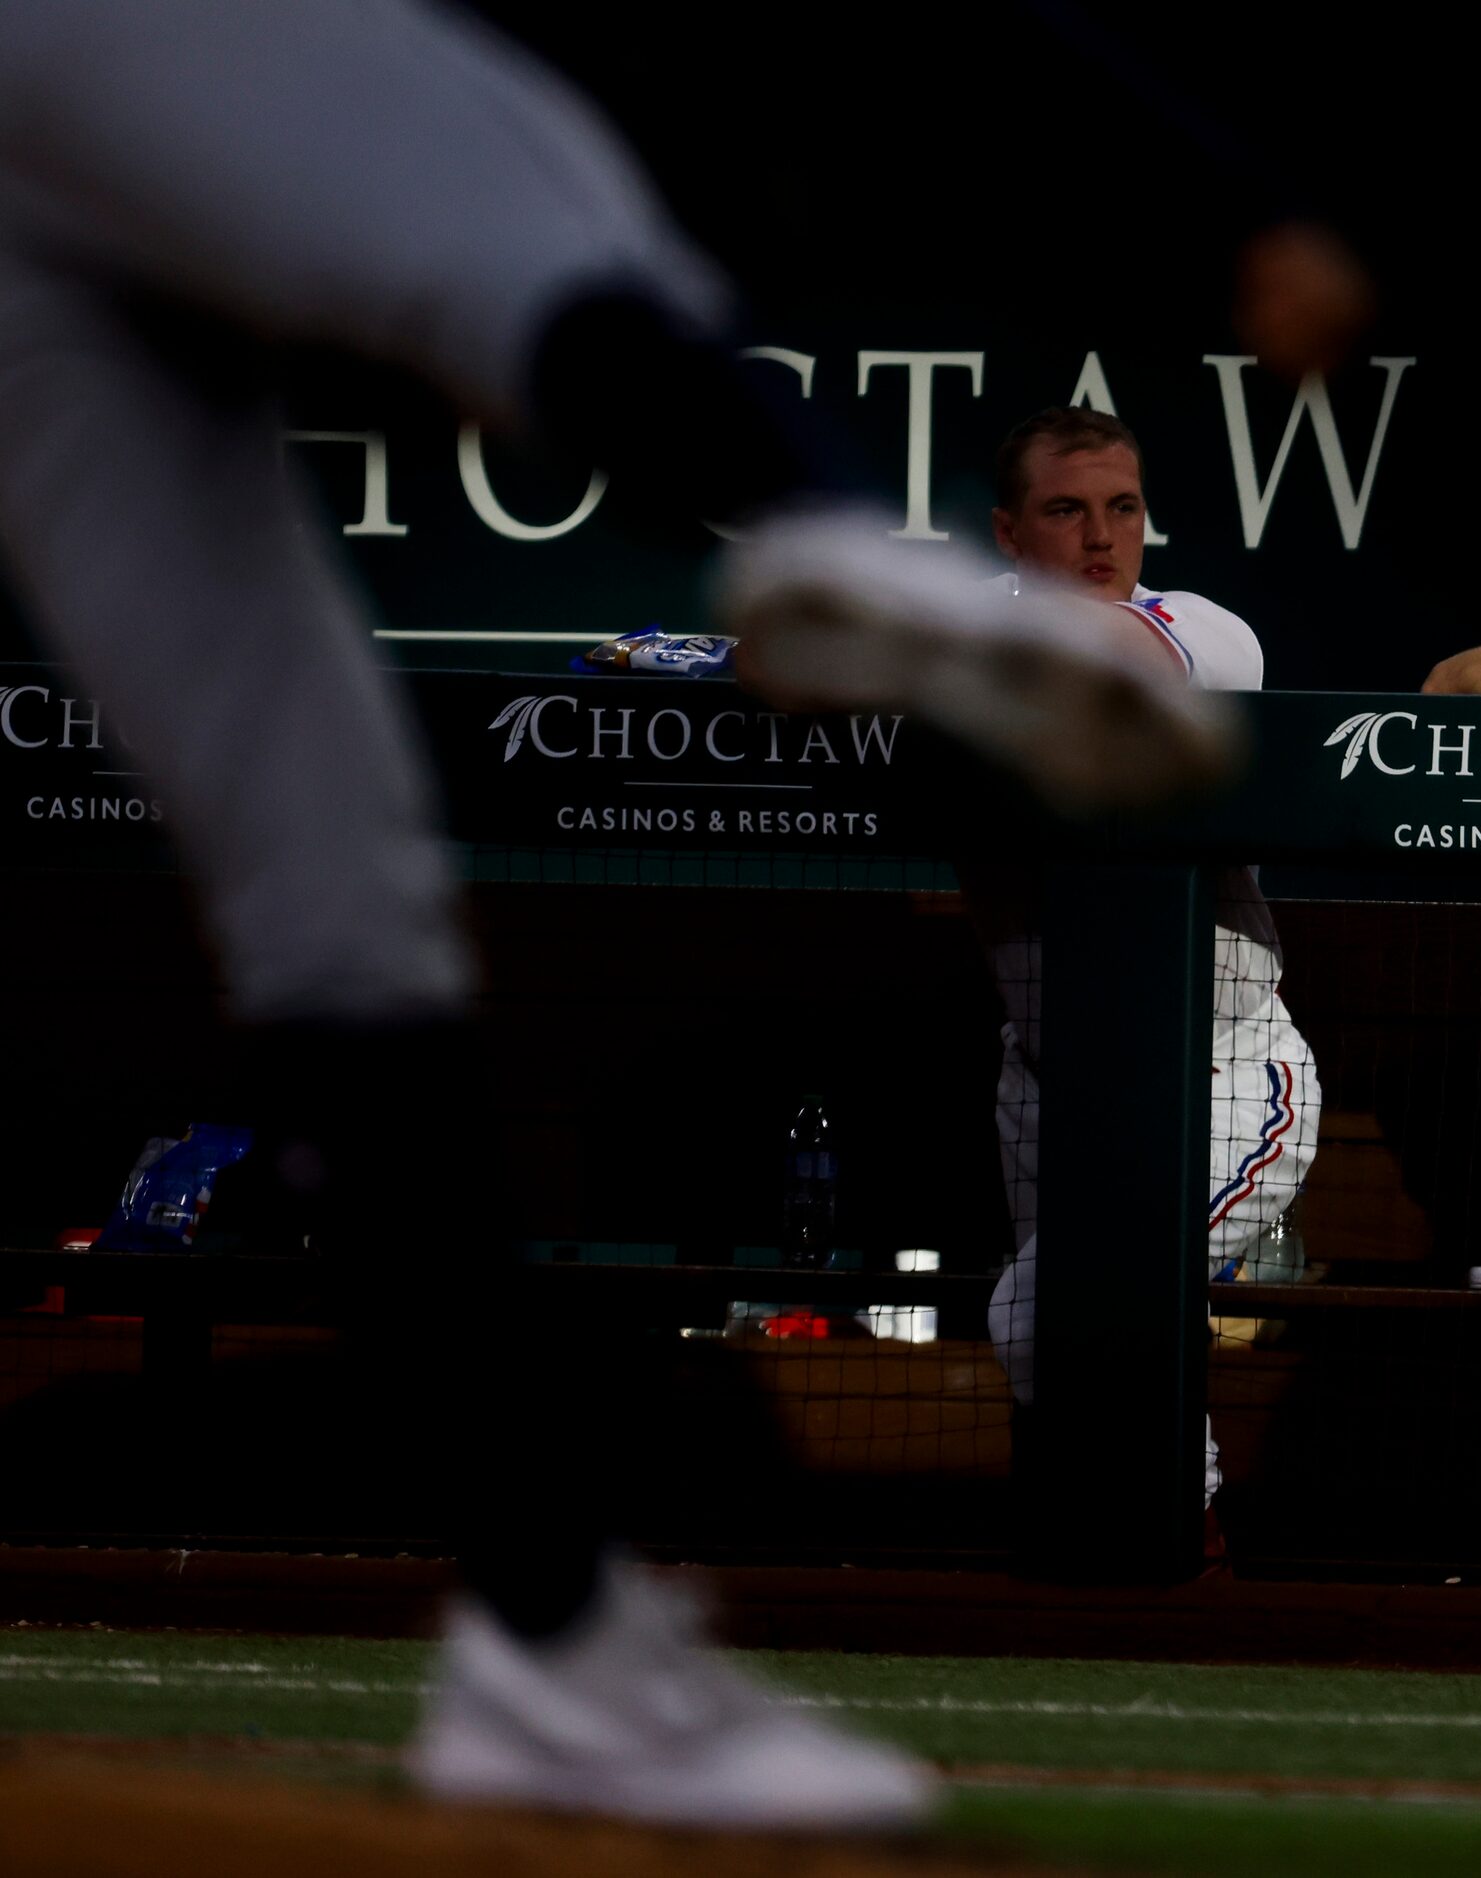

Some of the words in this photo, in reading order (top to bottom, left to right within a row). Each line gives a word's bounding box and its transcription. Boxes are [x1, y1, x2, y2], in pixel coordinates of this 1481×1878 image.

[529, 695, 904, 765] CHOCTAW
[556, 807, 695, 832] CASINOS
[708, 810, 725, 833] &
[738, 811, 878, 836] RESORTS
